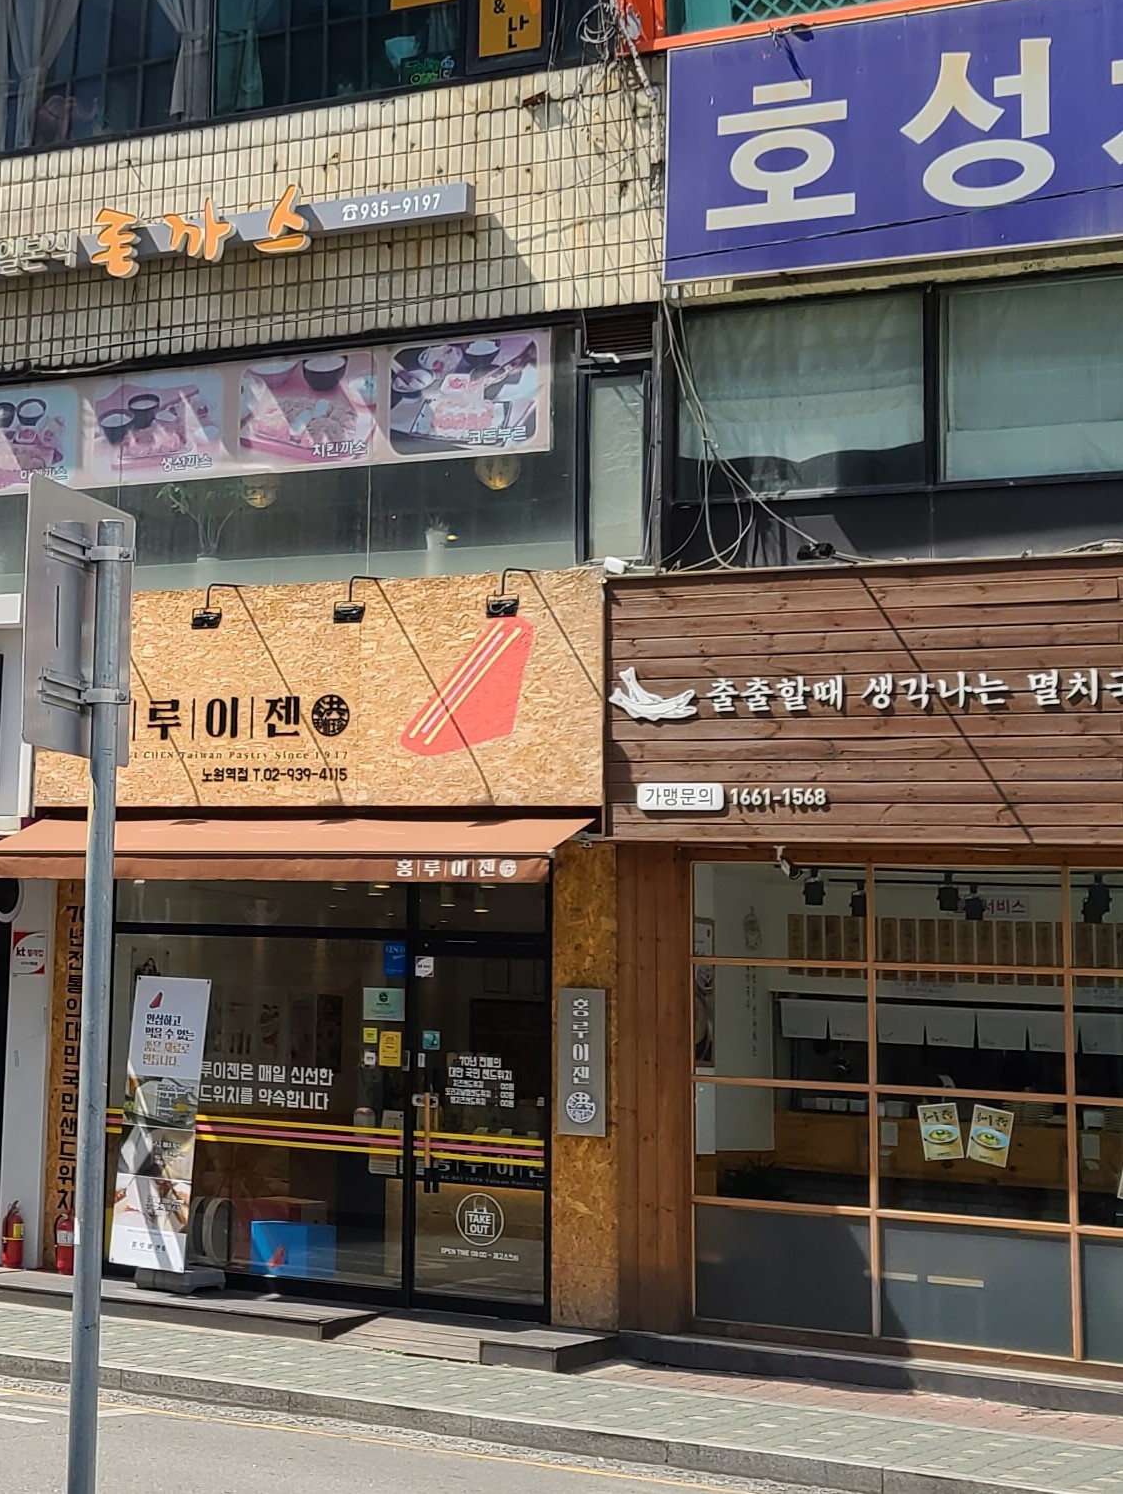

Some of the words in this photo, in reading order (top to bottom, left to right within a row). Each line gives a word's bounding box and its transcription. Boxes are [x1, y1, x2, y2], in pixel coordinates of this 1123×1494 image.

[493, 0, 506, 14] &
[706, 37, 1123, 231] 호성
[360, 193, 441, 220] 935-9197
[311, 439, 368, 458] 치킨까스
[706, 675, 844, 712] 출출할때
[860, 669, 1010, 710] 생각나는
[645, 787, 715, 806] 가맹문의
[729, 787, 827, 807] 1661-1568
[16, 947, 26, 957] kt
[146, 1013, 182, 1026] 안심하고
[165, 1028, 174, 1040] 수
[258, 1064, 286, 1083] 매일
[291, 1066, 334, 1086] 신선한
[258, 1089, 330, 1111] 약속합니다
[468, 1213, 492, 1224] TAKE
[469, 1224, 490, 1234] OUT
